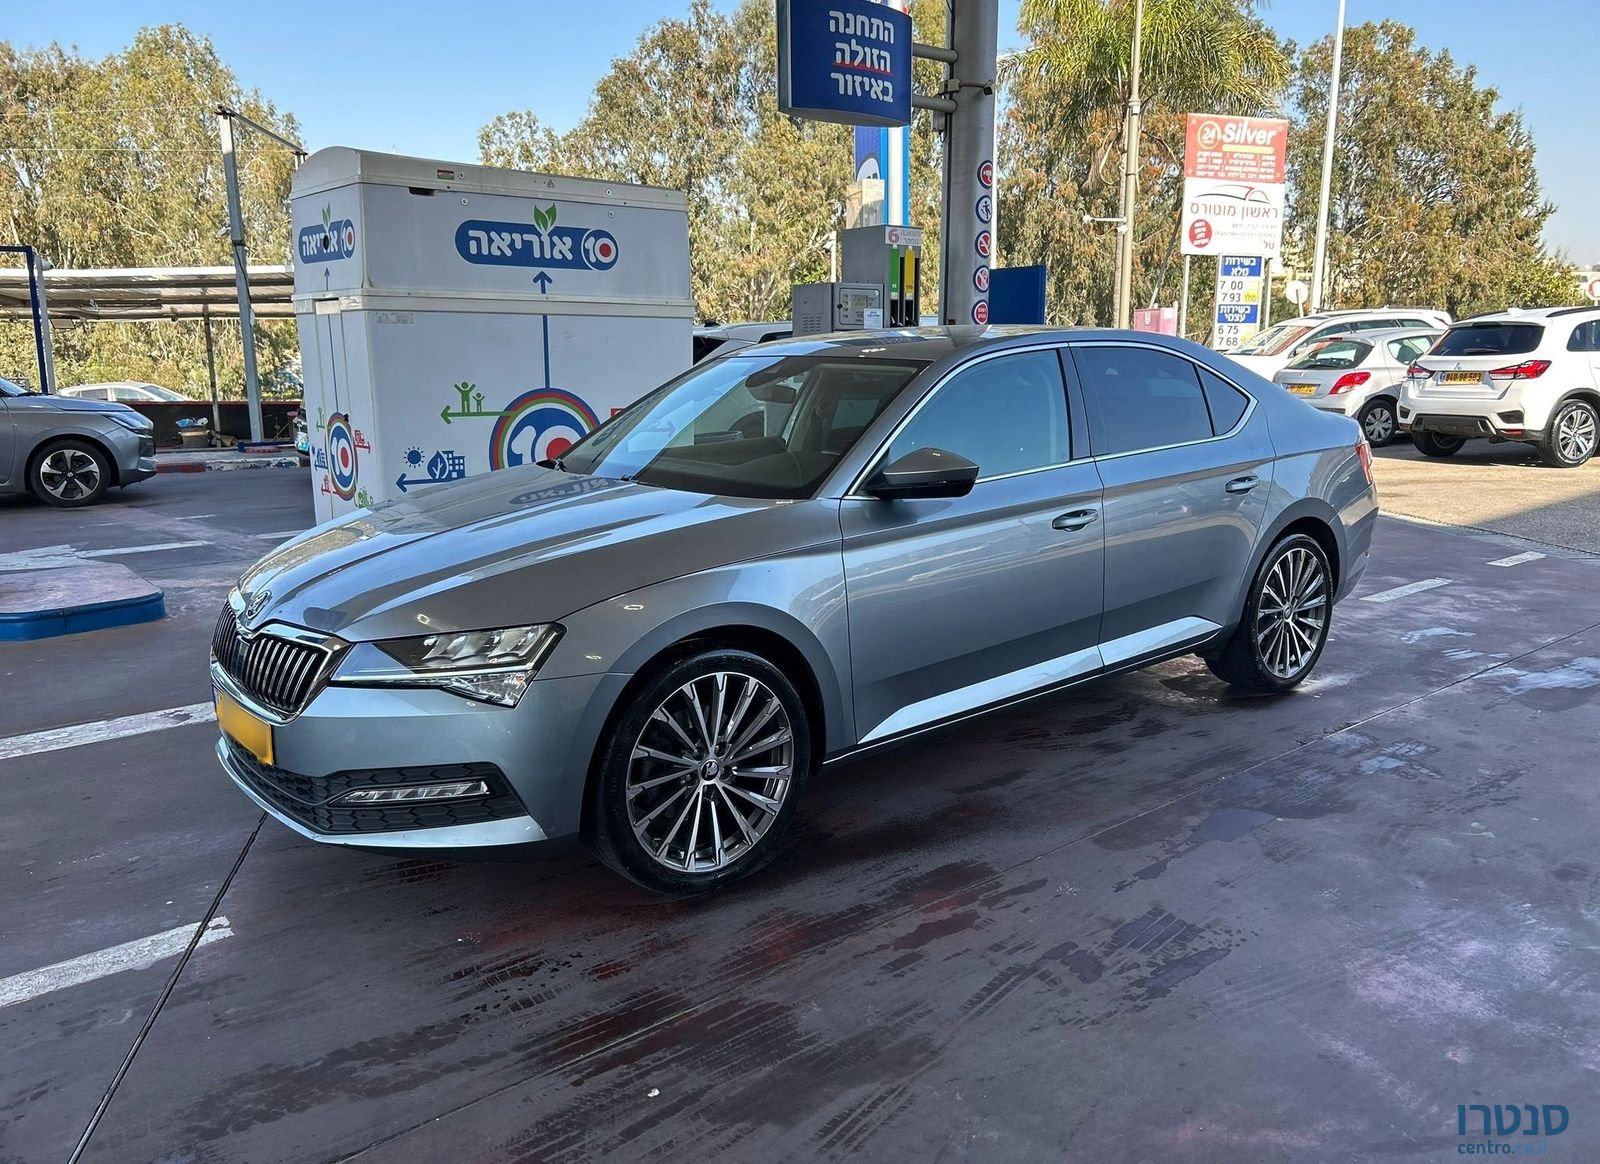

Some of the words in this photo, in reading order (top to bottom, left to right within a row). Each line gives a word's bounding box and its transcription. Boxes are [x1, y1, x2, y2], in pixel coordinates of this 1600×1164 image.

[829, 10, 894, 44] התחנה
[835, 38, 891, 73] הזולה
[830, 73, 893, 103] באיזור
[1202, 127, 1216, 140] 24
[1222, 119, 1277, 145] Silver
[1191, 203, 1236, 216] מוטורס
[1242, 206, 1278, 220] ראשון
[341, 226, 354, 252] 10
[468, 229, 573, 260] אוריאה
[888, 229, 899, 243] 6
[584, 236, 616, 264] 10
[1225, 256, 1256, 266] בשירות
[1231, 266, 1249, 276] מלא
[1219, 305, 1251, 314] בשירות
[1224, 313, 1246, 323] עצמי
